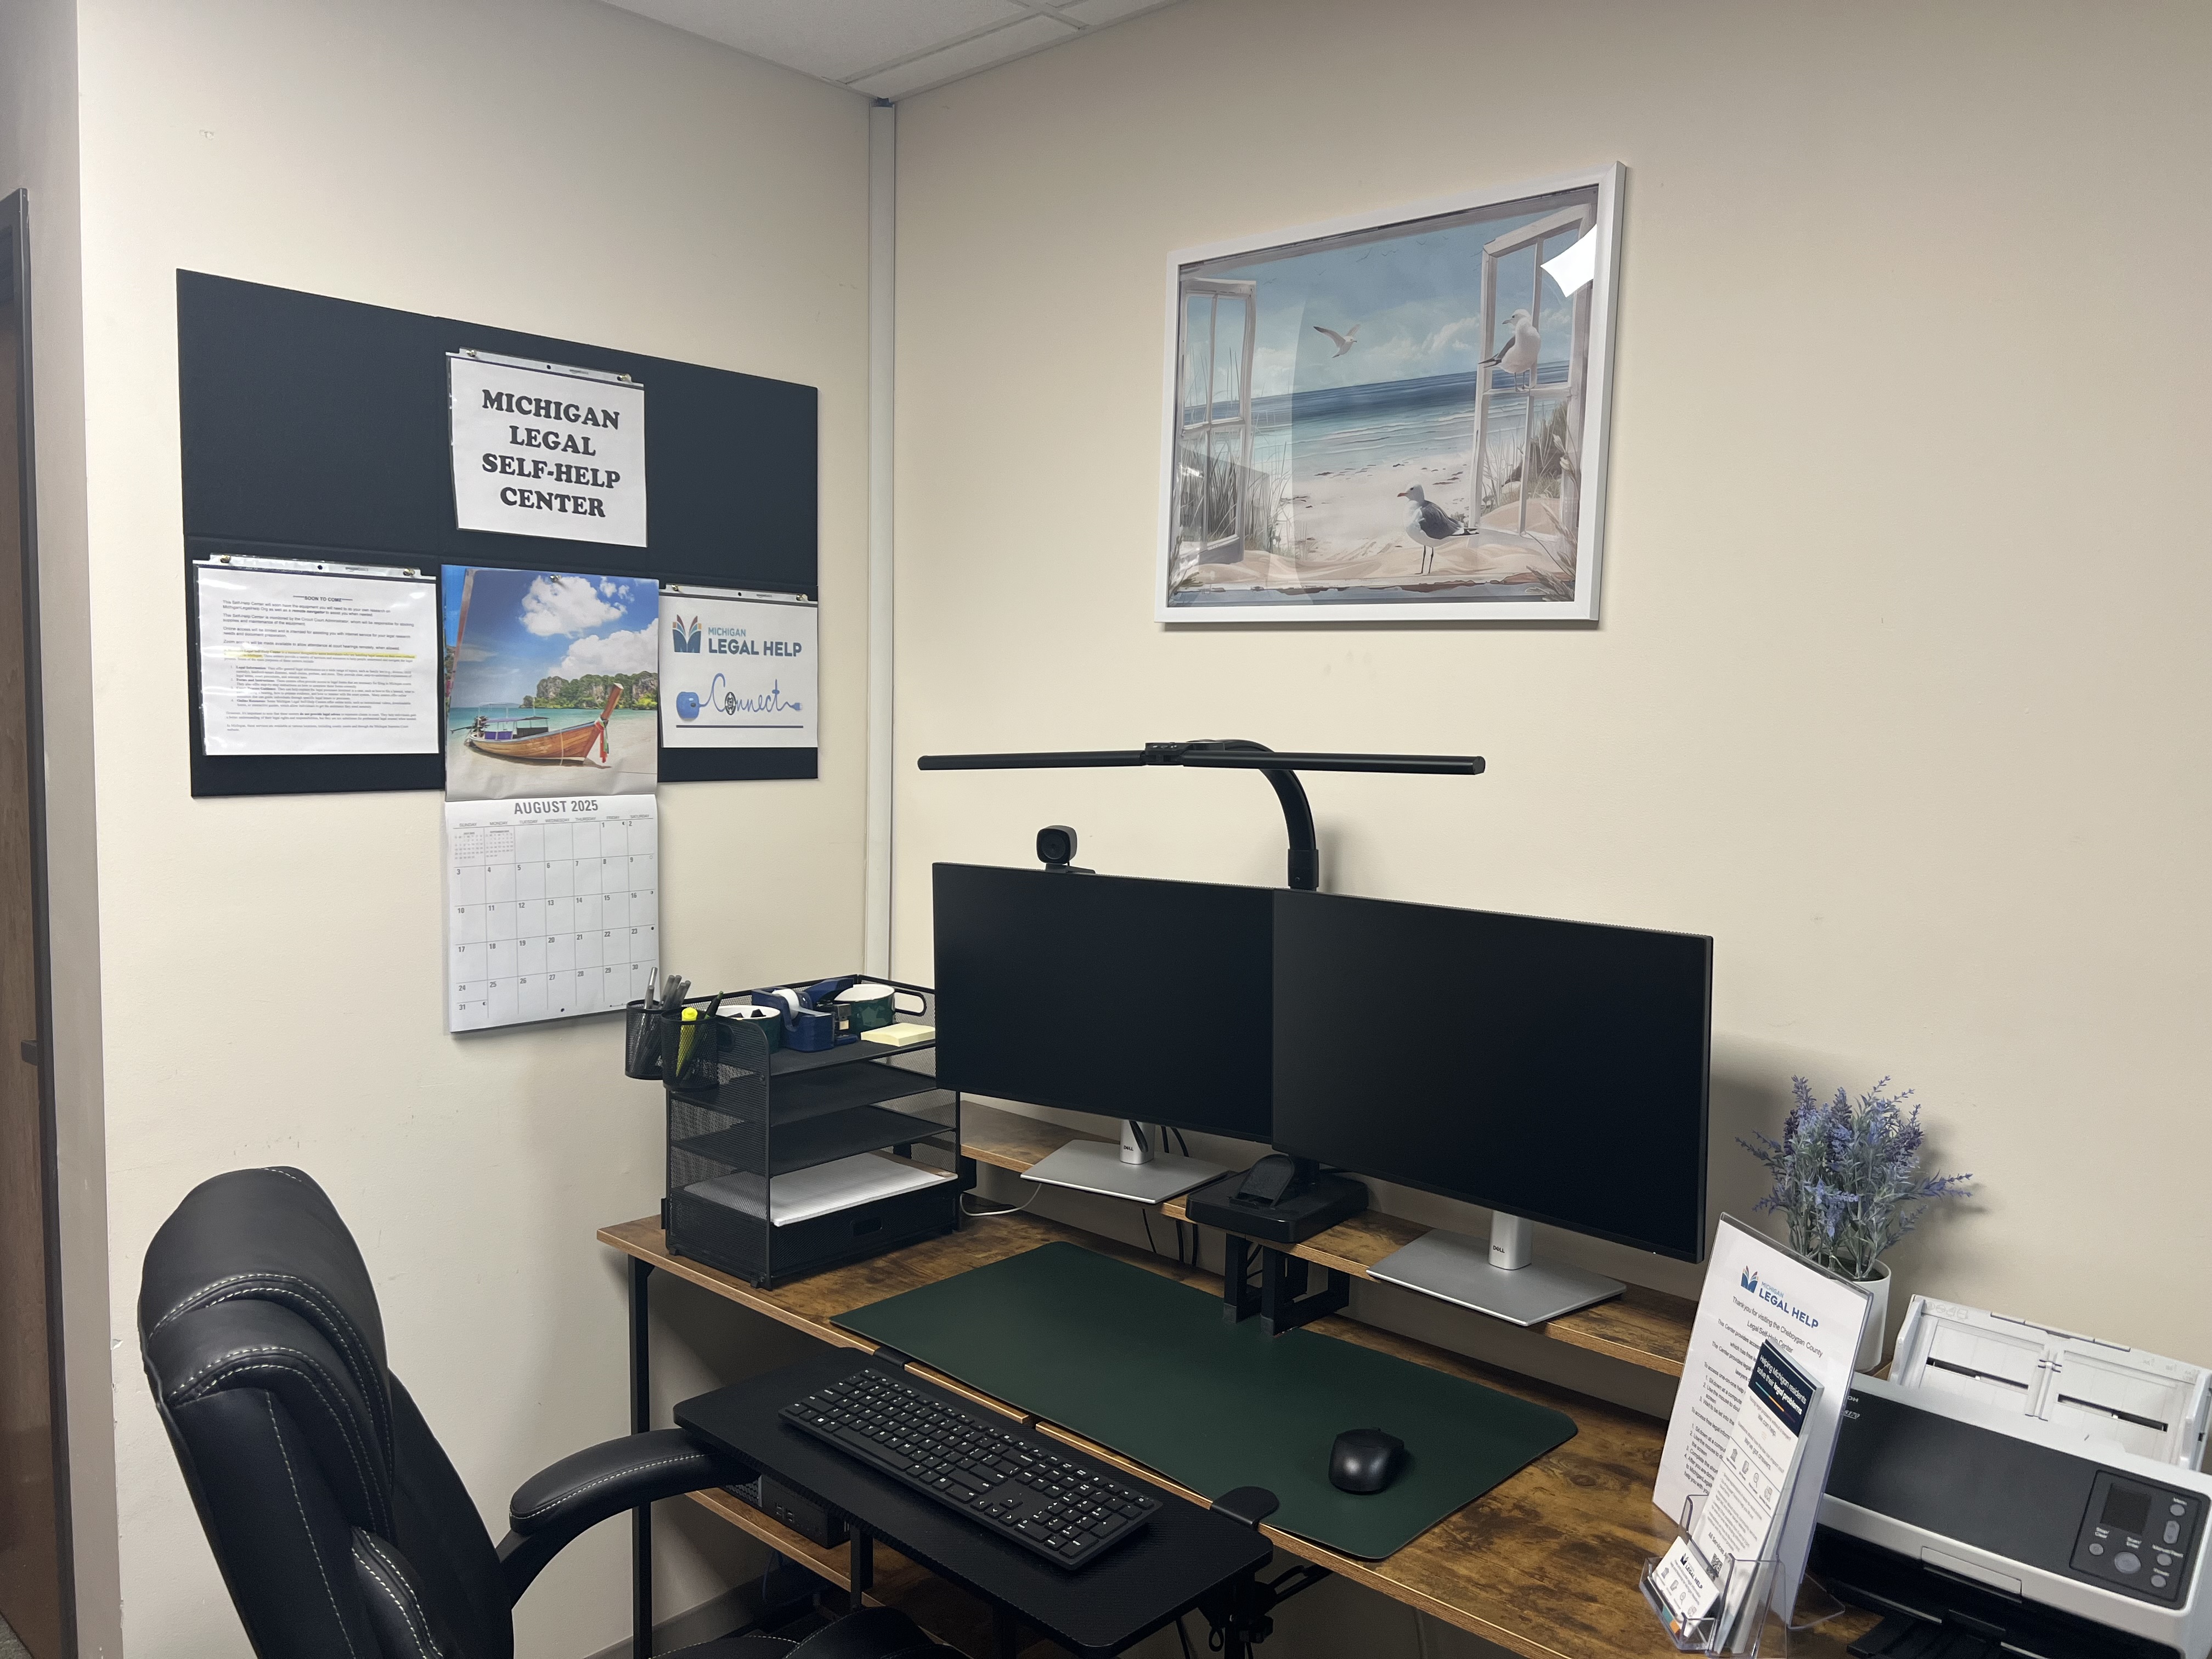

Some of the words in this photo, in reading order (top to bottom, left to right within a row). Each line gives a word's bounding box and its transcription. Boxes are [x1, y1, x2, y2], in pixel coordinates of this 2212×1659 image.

[482, 389, 620, 430] MICHIGAN
[509, 425, 596, 456] LEGAL
[482, 453, 620, 489] SELF-HELP
[500, 487, 606, 517] CENTER
[708, 627, 746, 637] MICHIGAN
[708, 638, 759, 656] LEGAL
[764, 641, 802, 657] HELP
[514, 800, 567, 815] AUGUST
[571, 800, 598, 812] 2025
[1493, 1245, 1505, 1254] DELL
[1762, 1282, 1784, 1298] MICHIGAN
[1759, 1288, 1789, 1313] LEGAL
[1792, 1307, 1819, 1328] HELP
[1725, 1323, 1735, 1334] Center
[1735, 1331, 1748, 1343] provides
[1733, 1296, 1744, 1308] Thank
[1743, 1304, 1752, 1312] you
[1758, 1312, 1773, 1327] visiting
[1780, 1326, 1805, 1346] Cheboygan
[1806, 1342, 1823, 1358] County
[1747, 1320, 1759, 1332] Legal
[1779, 1340, 1793, 1353] Center
[1719, 1346, 1729, 1356] Center
[1729, 1353, 1743, 1366] provides
[1743, 1362, 1752, 1371] legal
[1730, 1342, 1740, 1351] which
[1708, 1365, 1718, 1375] access
[1760, 1355, 1773, 1374] Helping
[1773, 1367, 1789, 1388] Michigan
[1788, 1384, 1807, 1404] residents
[1713, 1381, 1722, 1390] down
[1757, 1367, 1767, 1379] solve
[1765, 1374, 1775, 1386] their
[1773, 1381, 1784, 1396] legal
[1782, 1393, 1803, 1415] problems
[1718, 1394, 1729, 1404] mouse
[1685, 1565, 1695, 1579] LEGAL
[1694, 1577, 1703, 1589] HELP
